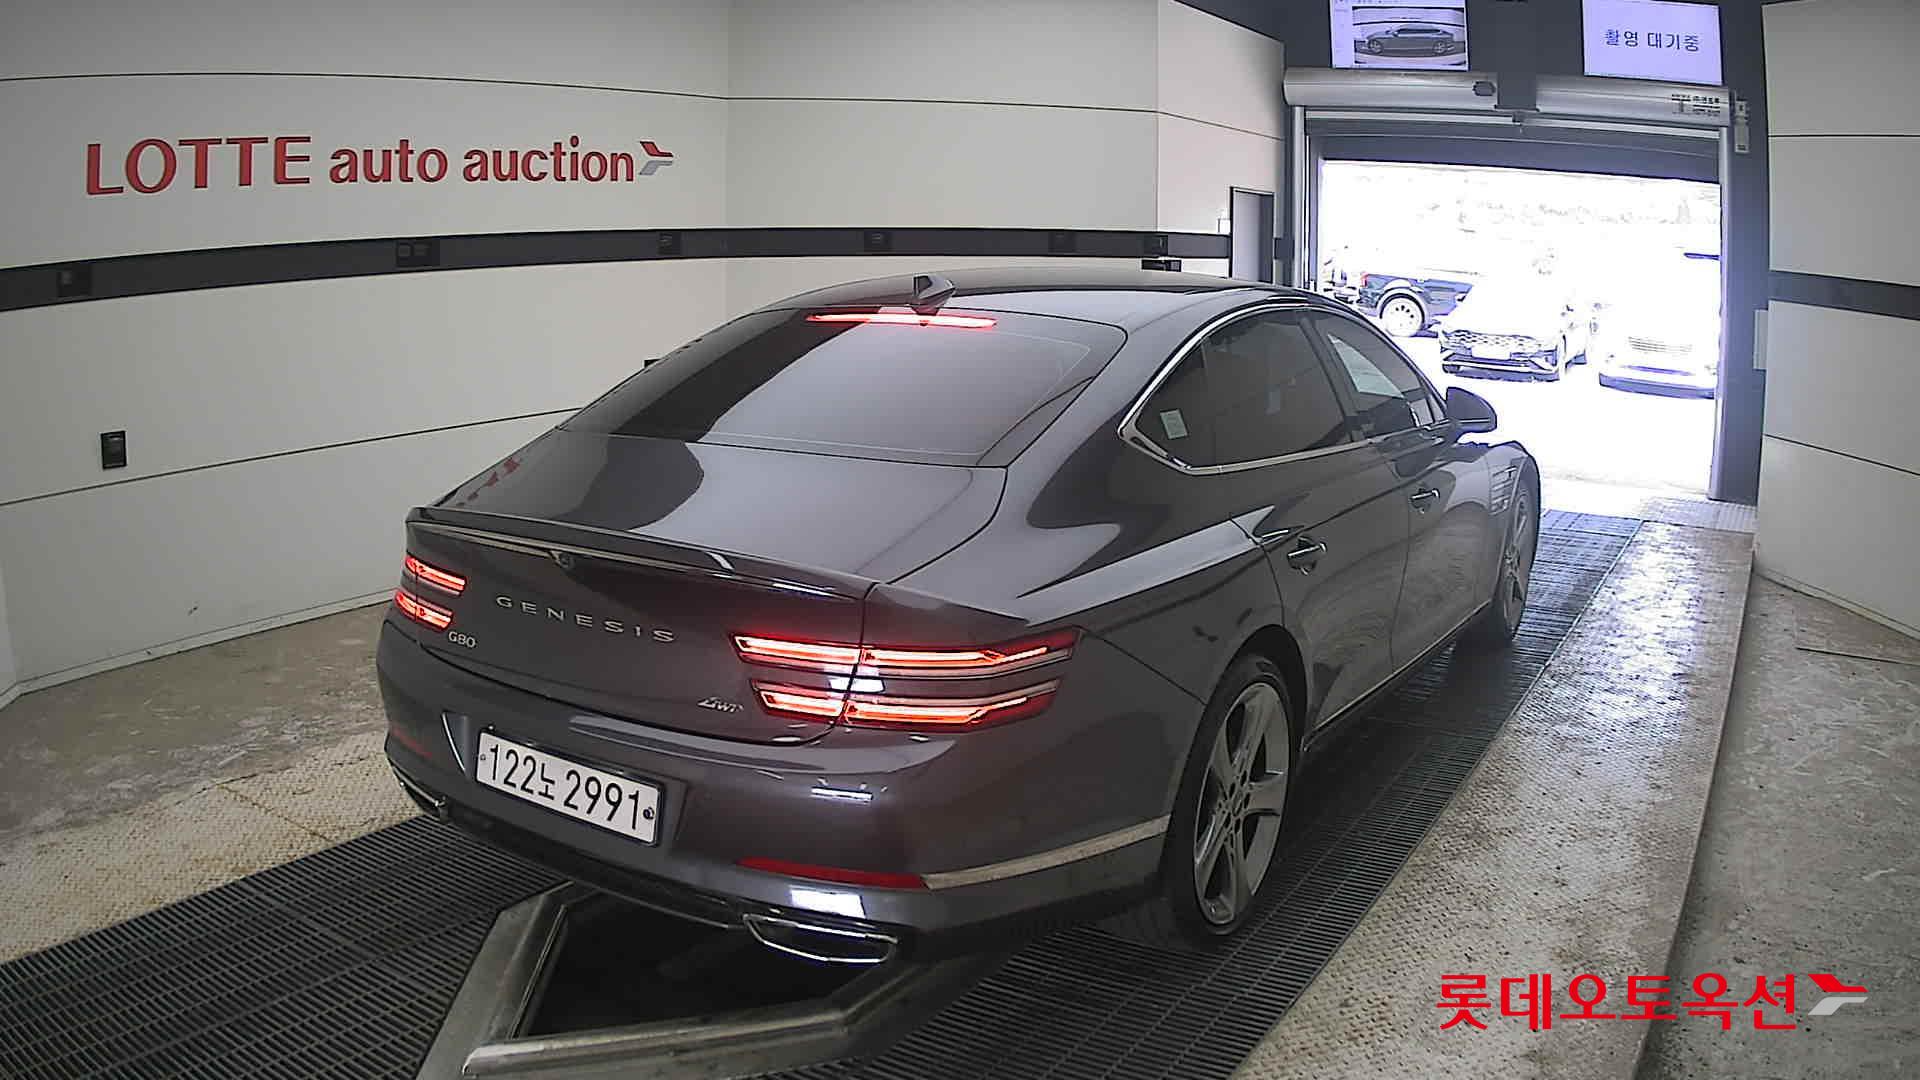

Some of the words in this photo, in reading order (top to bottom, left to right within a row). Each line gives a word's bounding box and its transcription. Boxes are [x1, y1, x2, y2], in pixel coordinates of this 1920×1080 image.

[1647, 32, 1699, 52] 대기중
[86, 136, 311, 196] LOTTE
[328, 139, 448, 184] auto
[462, 136, 635, 183] auction
[496, 596, 675, 643] GENESIS
[448, 631, 477, 649] G80
